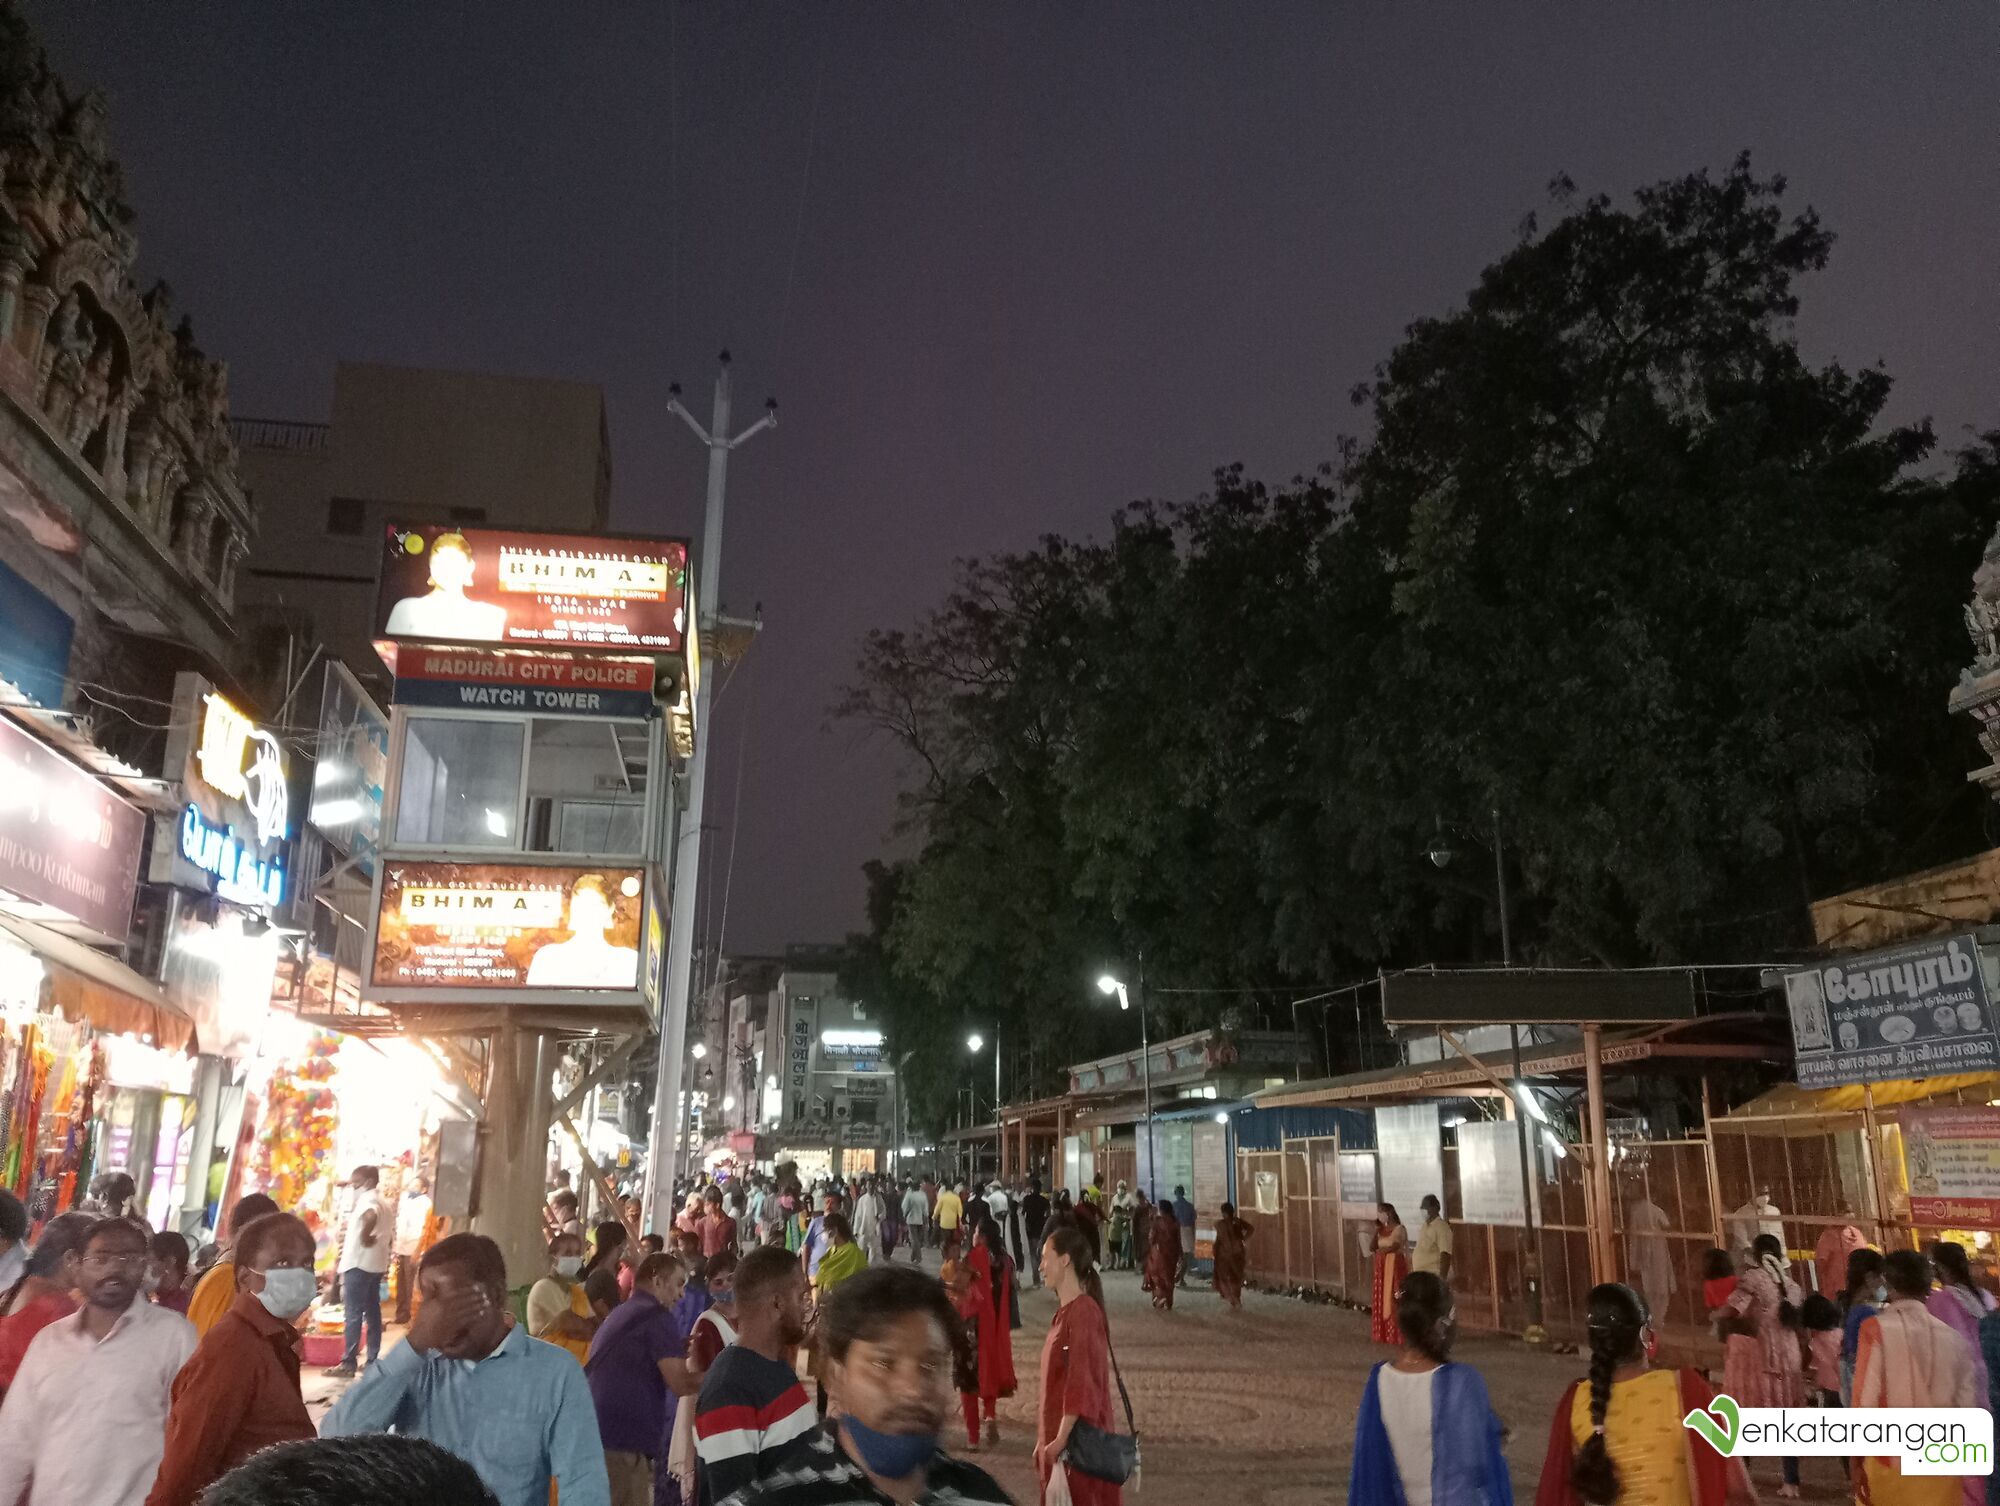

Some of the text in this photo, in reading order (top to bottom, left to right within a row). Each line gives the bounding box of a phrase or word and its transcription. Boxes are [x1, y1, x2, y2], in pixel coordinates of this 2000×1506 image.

[510, 562, 632, 581] BHIMA
[537, 595, 578, 606] INDIA
[425, 658, 637, 685] MADURAI CITY POLICE
[460, 687, 600, 710] WATCH TOWER
[411, 894, 528, 910] BHIMA
[1824, 940, 1973, 1004] கோபுரம்
[1838, 1053, 1894, 1071] வாசனை
